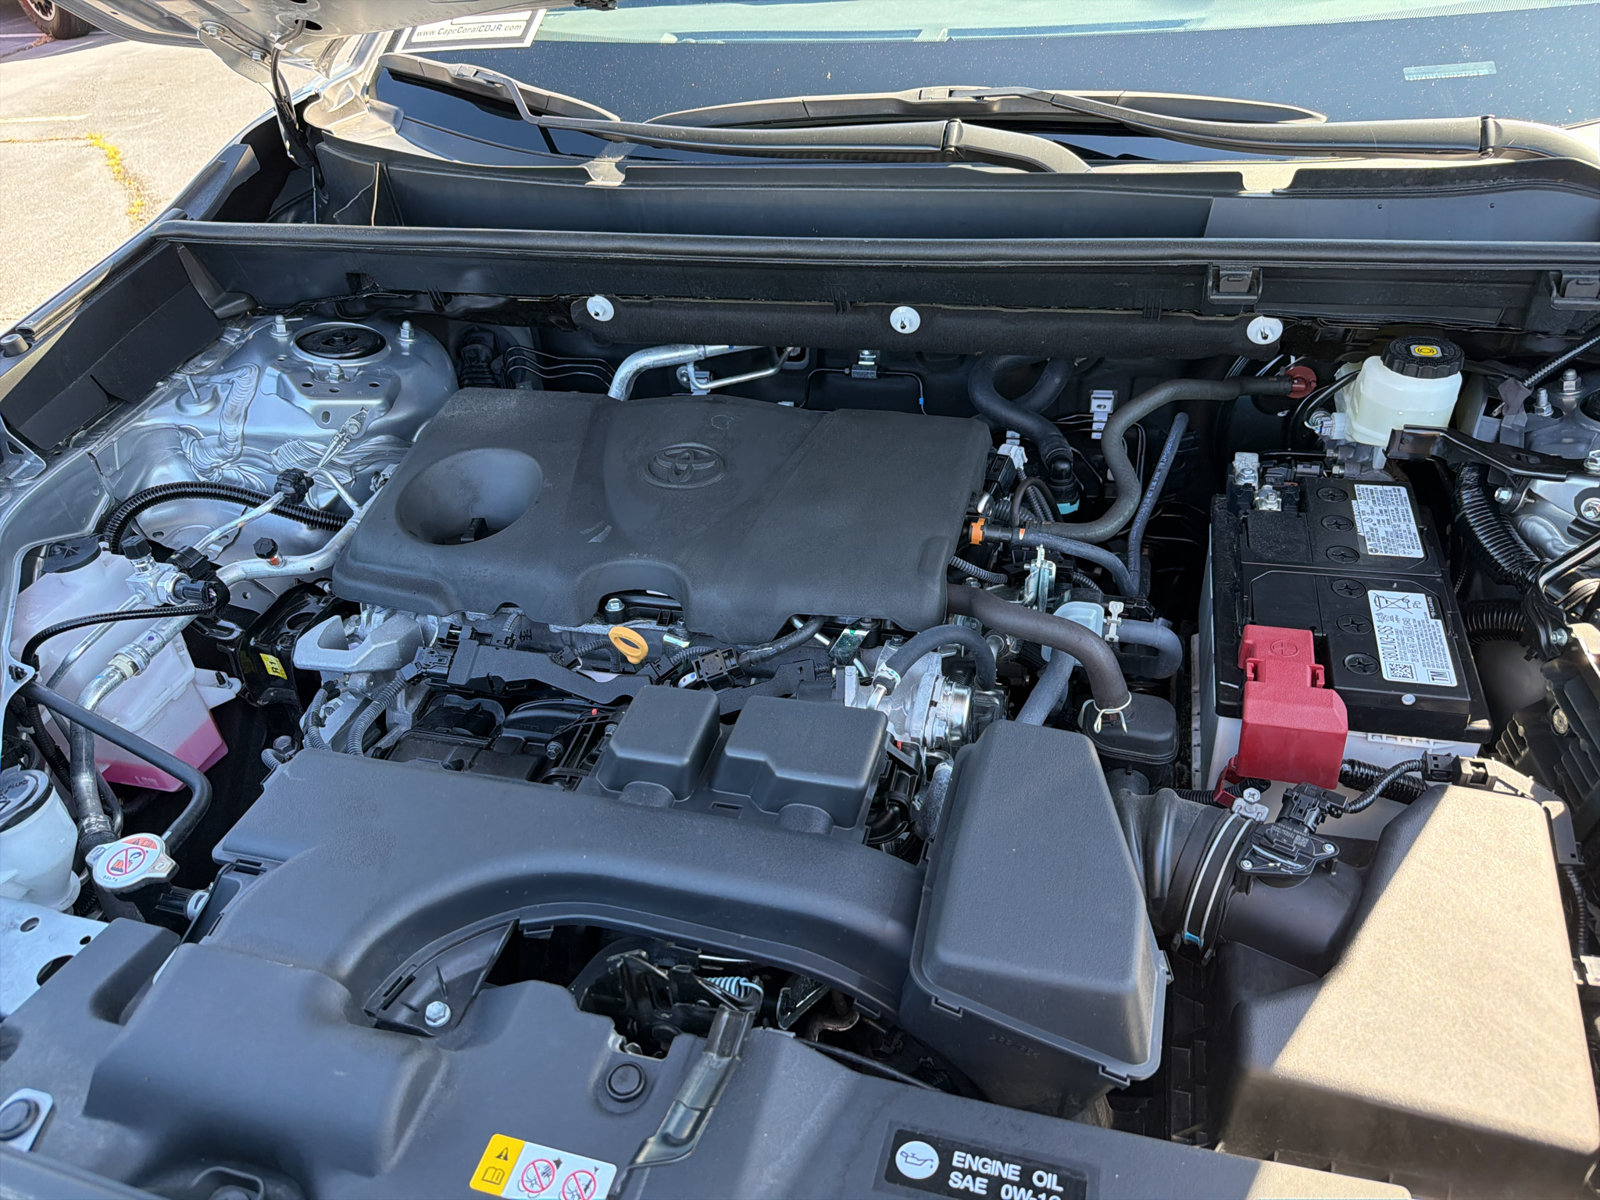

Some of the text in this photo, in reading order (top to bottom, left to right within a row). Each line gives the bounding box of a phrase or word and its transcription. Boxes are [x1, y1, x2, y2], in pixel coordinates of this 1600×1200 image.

[948, 1171, 989, 1195] SAE
[951, 1150, 1064, 1192] ENGINE OIL
